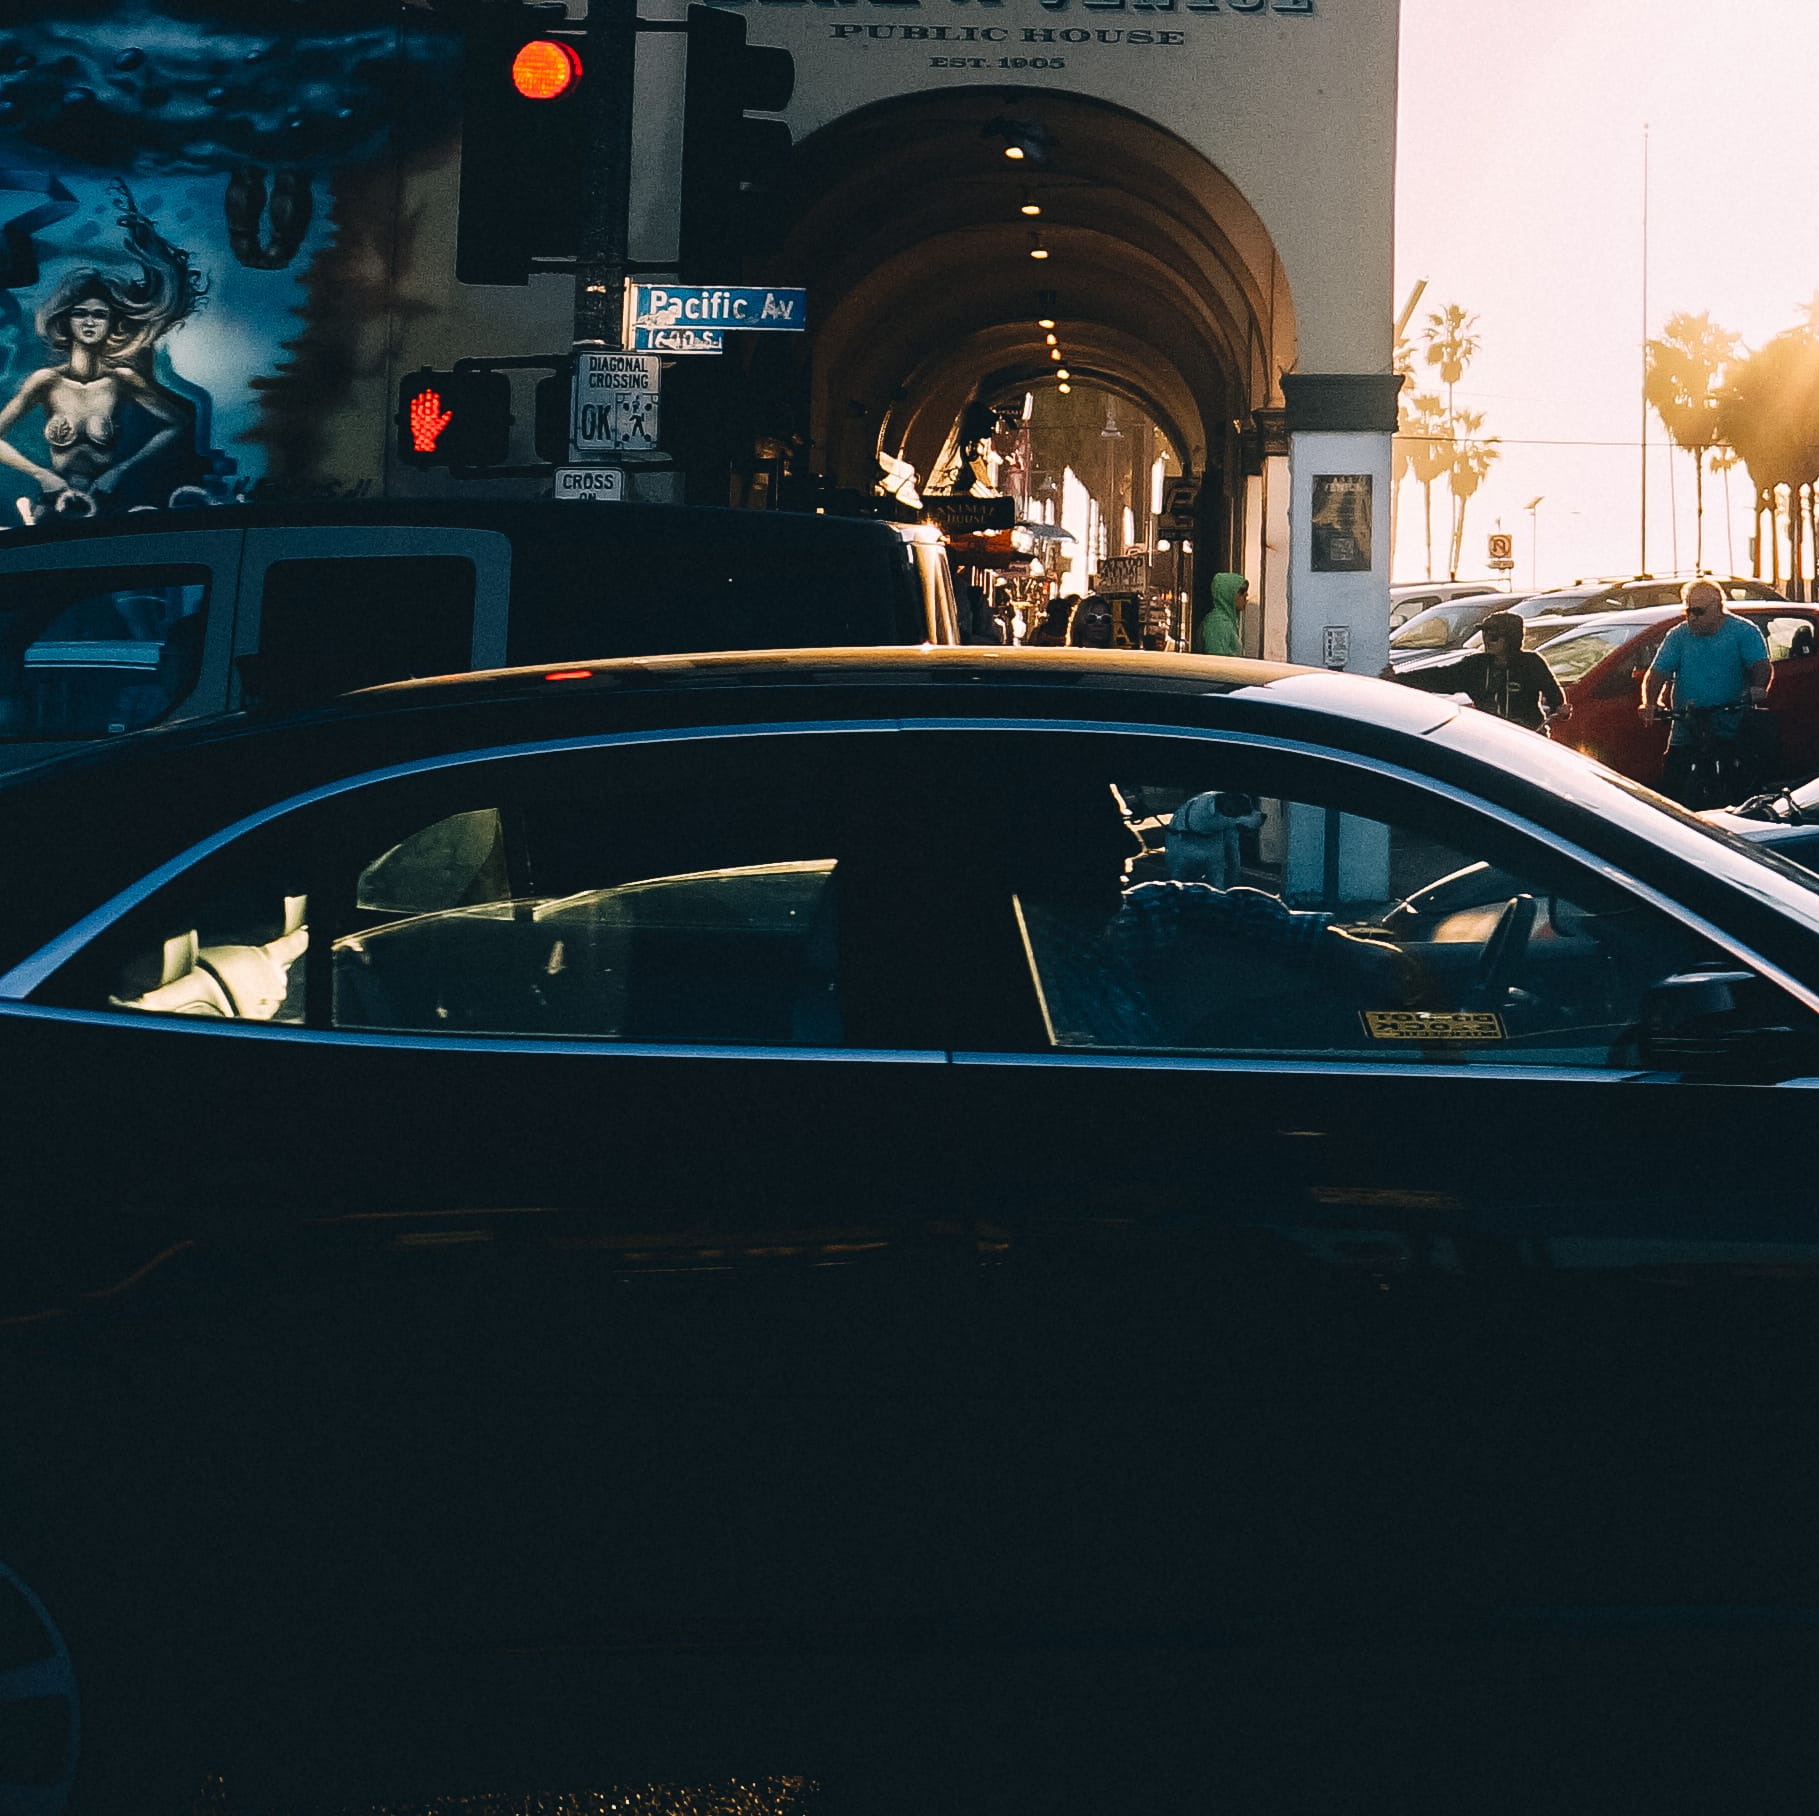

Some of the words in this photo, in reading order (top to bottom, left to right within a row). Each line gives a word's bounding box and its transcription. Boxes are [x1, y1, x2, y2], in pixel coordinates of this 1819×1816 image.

[829, 22, 1009, 43] PUBLIC
[1020, 26, 1185, 47] HOUSE
[929, 56, 994, 68] EST.
[997, 56, 1066, 69] 1905
[650, 290, 748, 321] Pacific
[760, 292, 795, 321] Av
[589, 357, 649, 372] DIAGONAL
[588, 373, 649, 389] CROSSING
[581, 404, 612, 441] OK
[562, 473, 614, 490] CROSS
